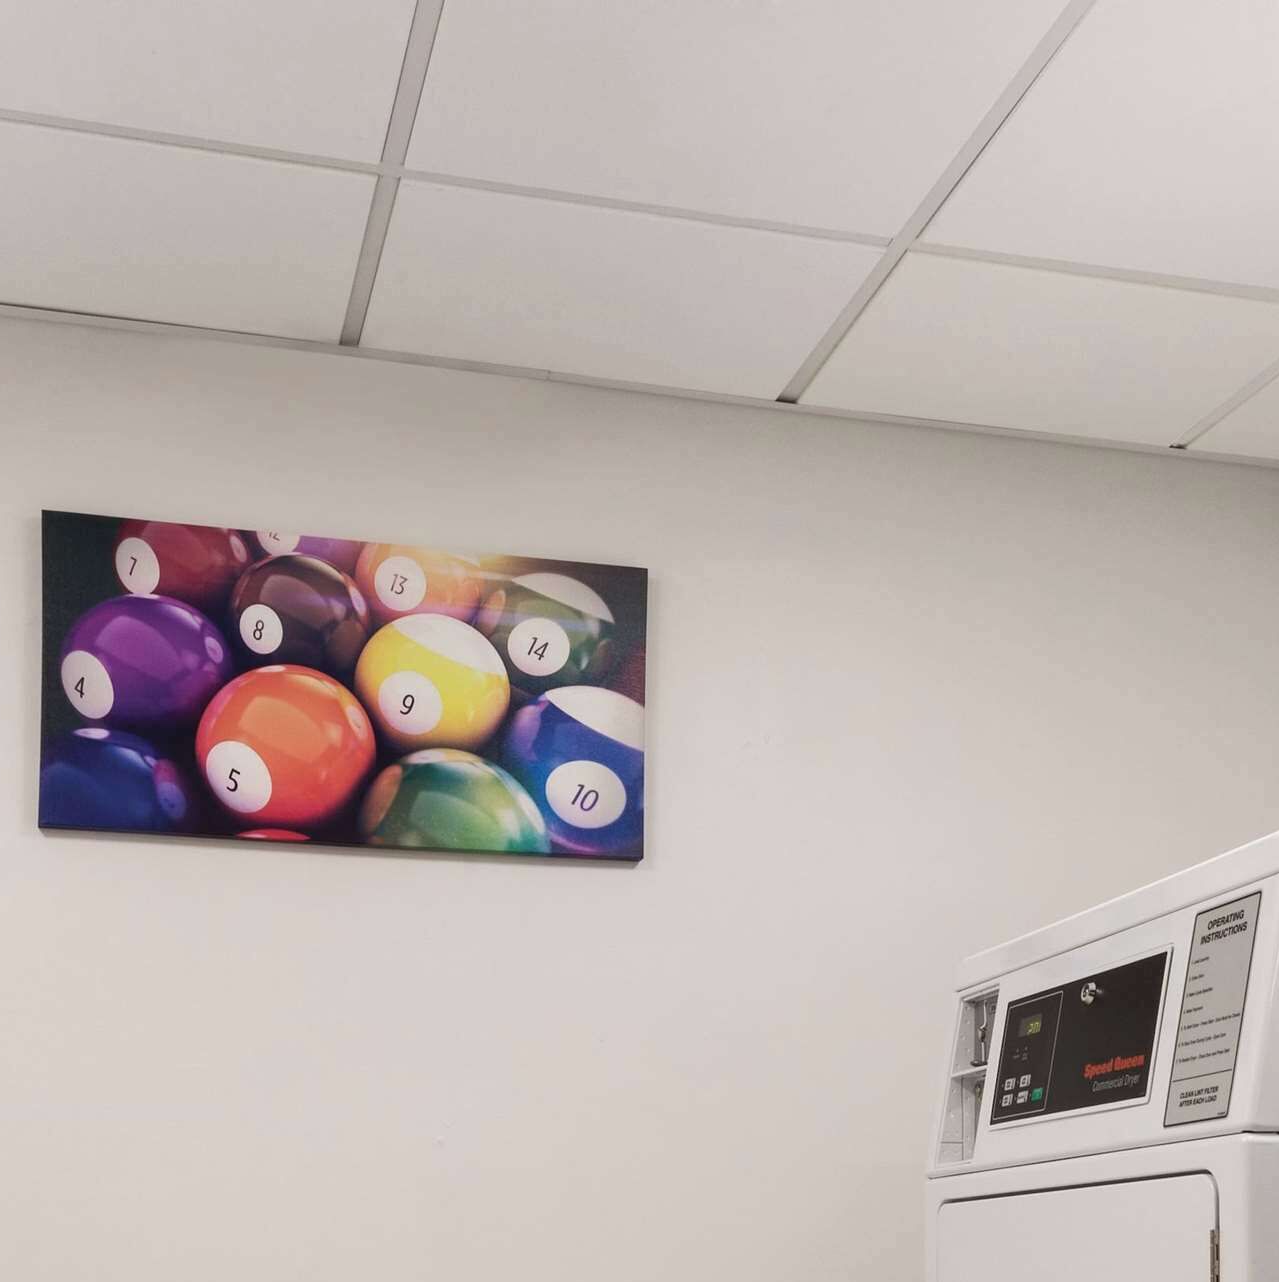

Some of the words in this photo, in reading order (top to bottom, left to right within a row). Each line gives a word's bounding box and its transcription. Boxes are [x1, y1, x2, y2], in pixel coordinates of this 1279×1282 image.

[129, 556, 137, 576] 7
[390, 574, 408, 594] 13
[253, 620, 264, 640] 8
[528, 637, 548, 660] 14
[74, 677, 84, 698] 4
[400, 694, 414, 715] 9
[226, 768, 240, 792] 5
[571, 784, 599, 812] 10
[1208, 910, 1244, 930] OPERATING
[1200, 921, 1247, 944] INSTRUCTIONS
[1083, 1057, 1113, 1080] Speed
[1114, 1055, 1145, 1071] Queen
